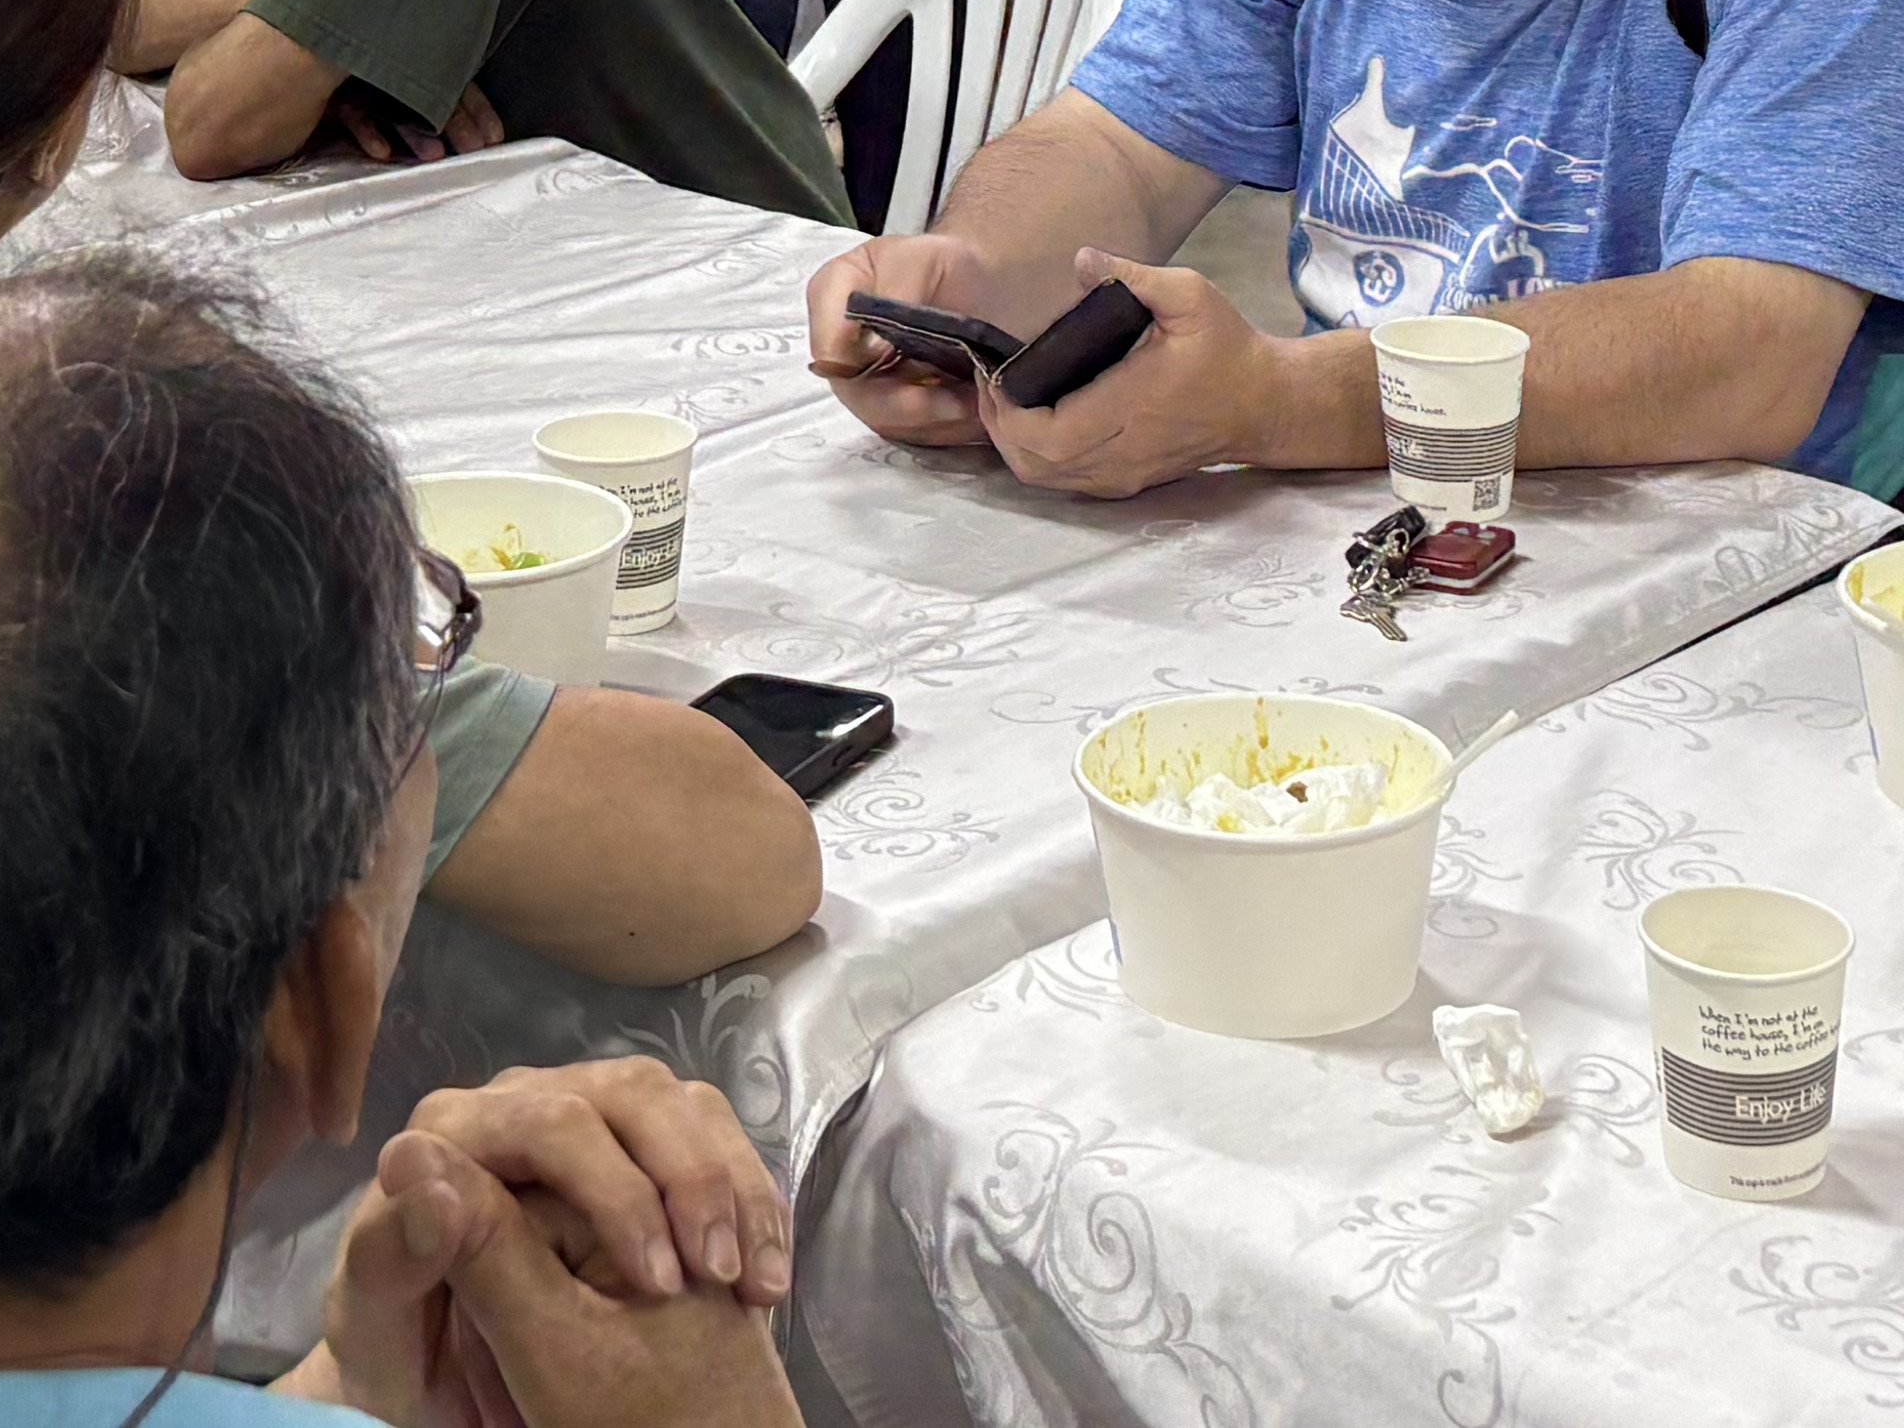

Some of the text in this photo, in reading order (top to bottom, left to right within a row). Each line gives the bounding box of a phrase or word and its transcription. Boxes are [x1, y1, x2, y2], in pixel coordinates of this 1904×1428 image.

[1698, 1004, 1818, 1026] When I'm not at the
[1701, 1024, 1747, 1041] coffee
[1749, 1027, 1789, 1042] house,
[1702, 1030, 1829, 1061] the way to the coffee
[1735, 1083, 1827, 1125] Enjoy Life
